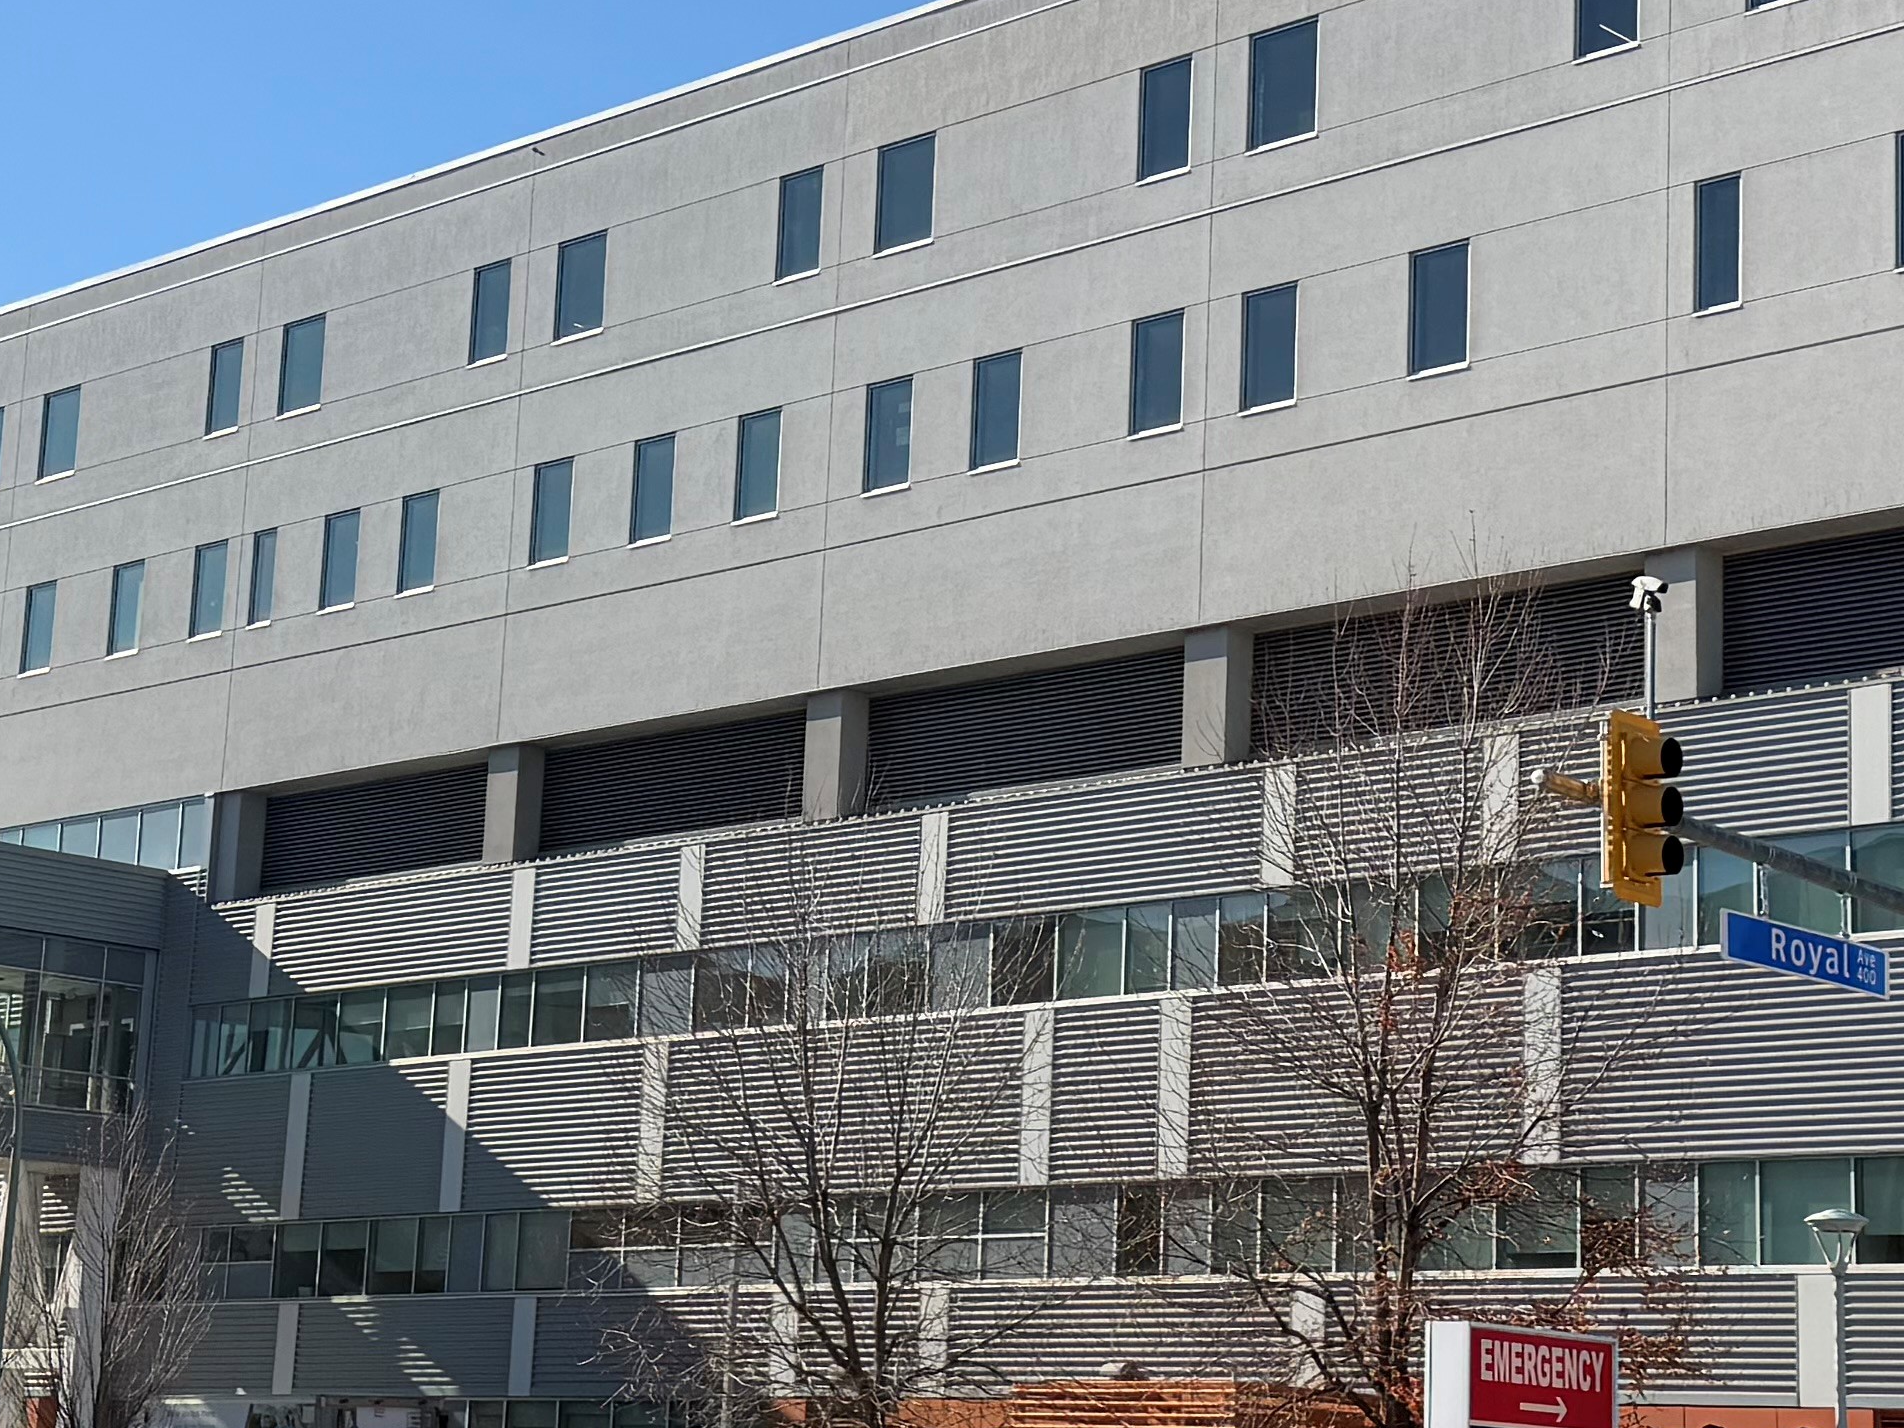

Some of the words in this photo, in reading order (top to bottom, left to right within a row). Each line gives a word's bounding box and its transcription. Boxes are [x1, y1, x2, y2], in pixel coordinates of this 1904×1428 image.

[1771, 927, 1850, 978] Royal
[1857, 949, 1876, 968] Ave
[1857, 966, 1876, 985] 400
[1480, 1338, 1604, 1393] EMERGENCY
